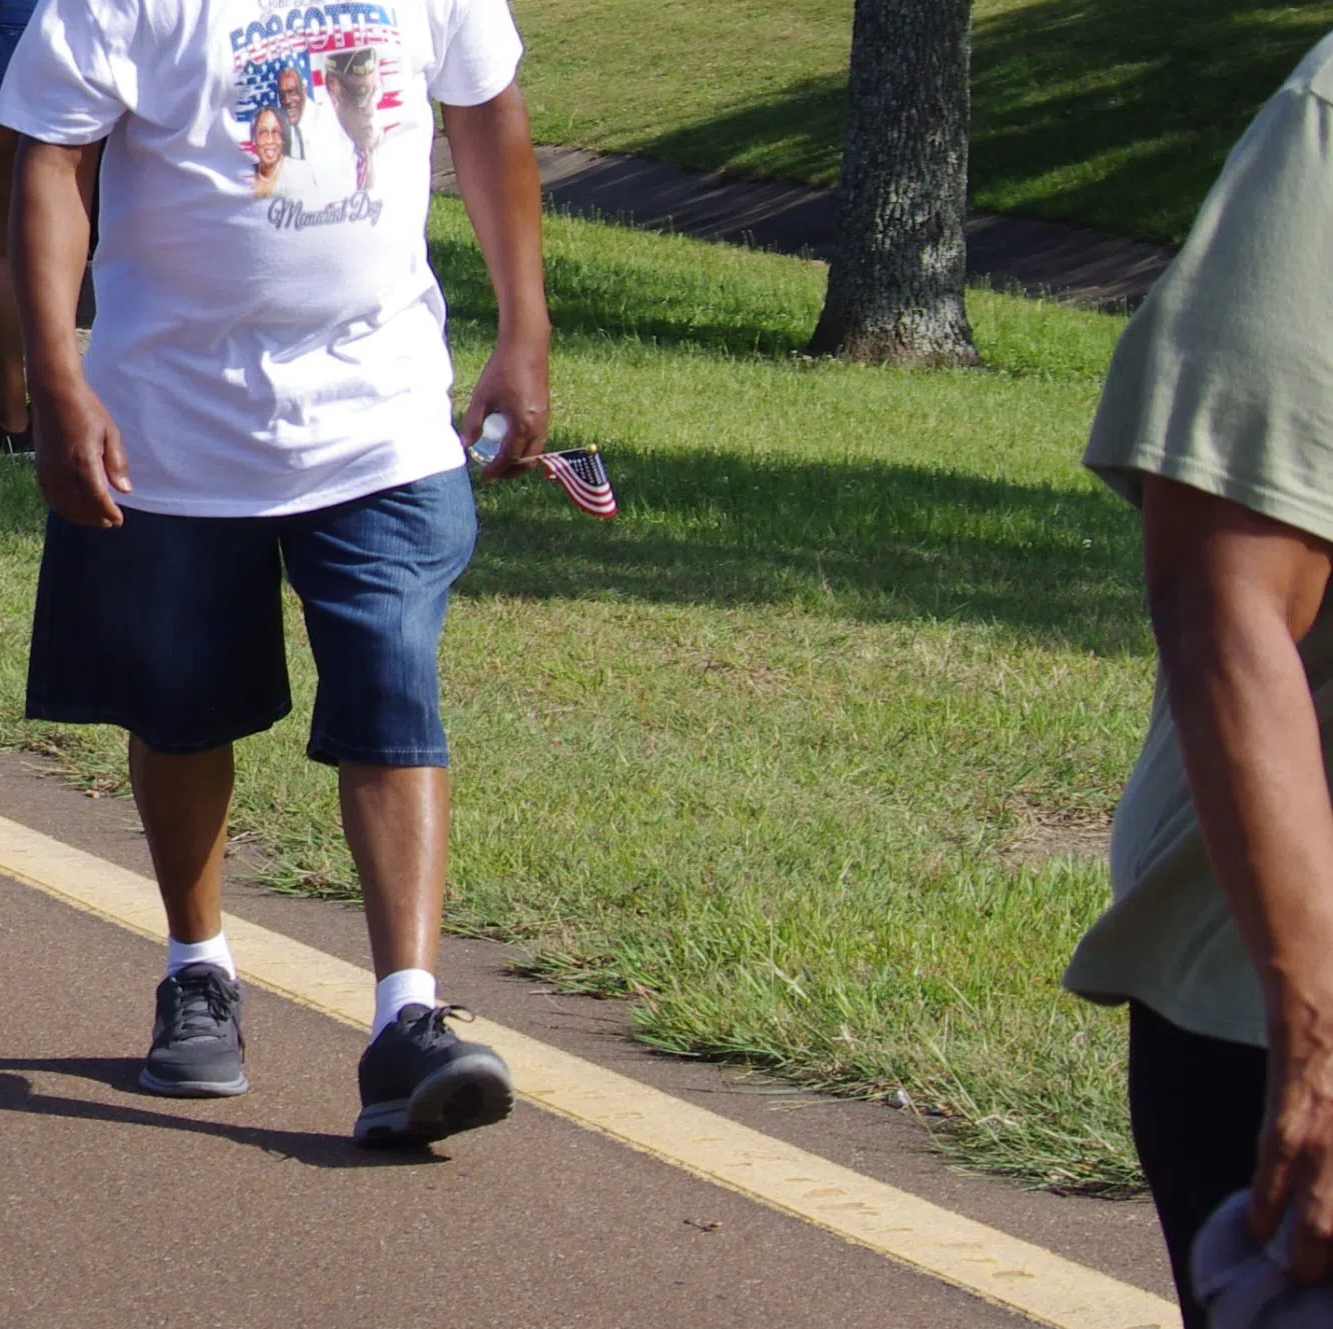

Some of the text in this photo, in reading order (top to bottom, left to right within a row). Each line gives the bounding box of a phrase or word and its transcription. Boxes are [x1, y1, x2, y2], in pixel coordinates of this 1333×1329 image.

[229, 1, 401, 73] FORGOTTEN
[267, 190, 384, 231] Memorial Day
